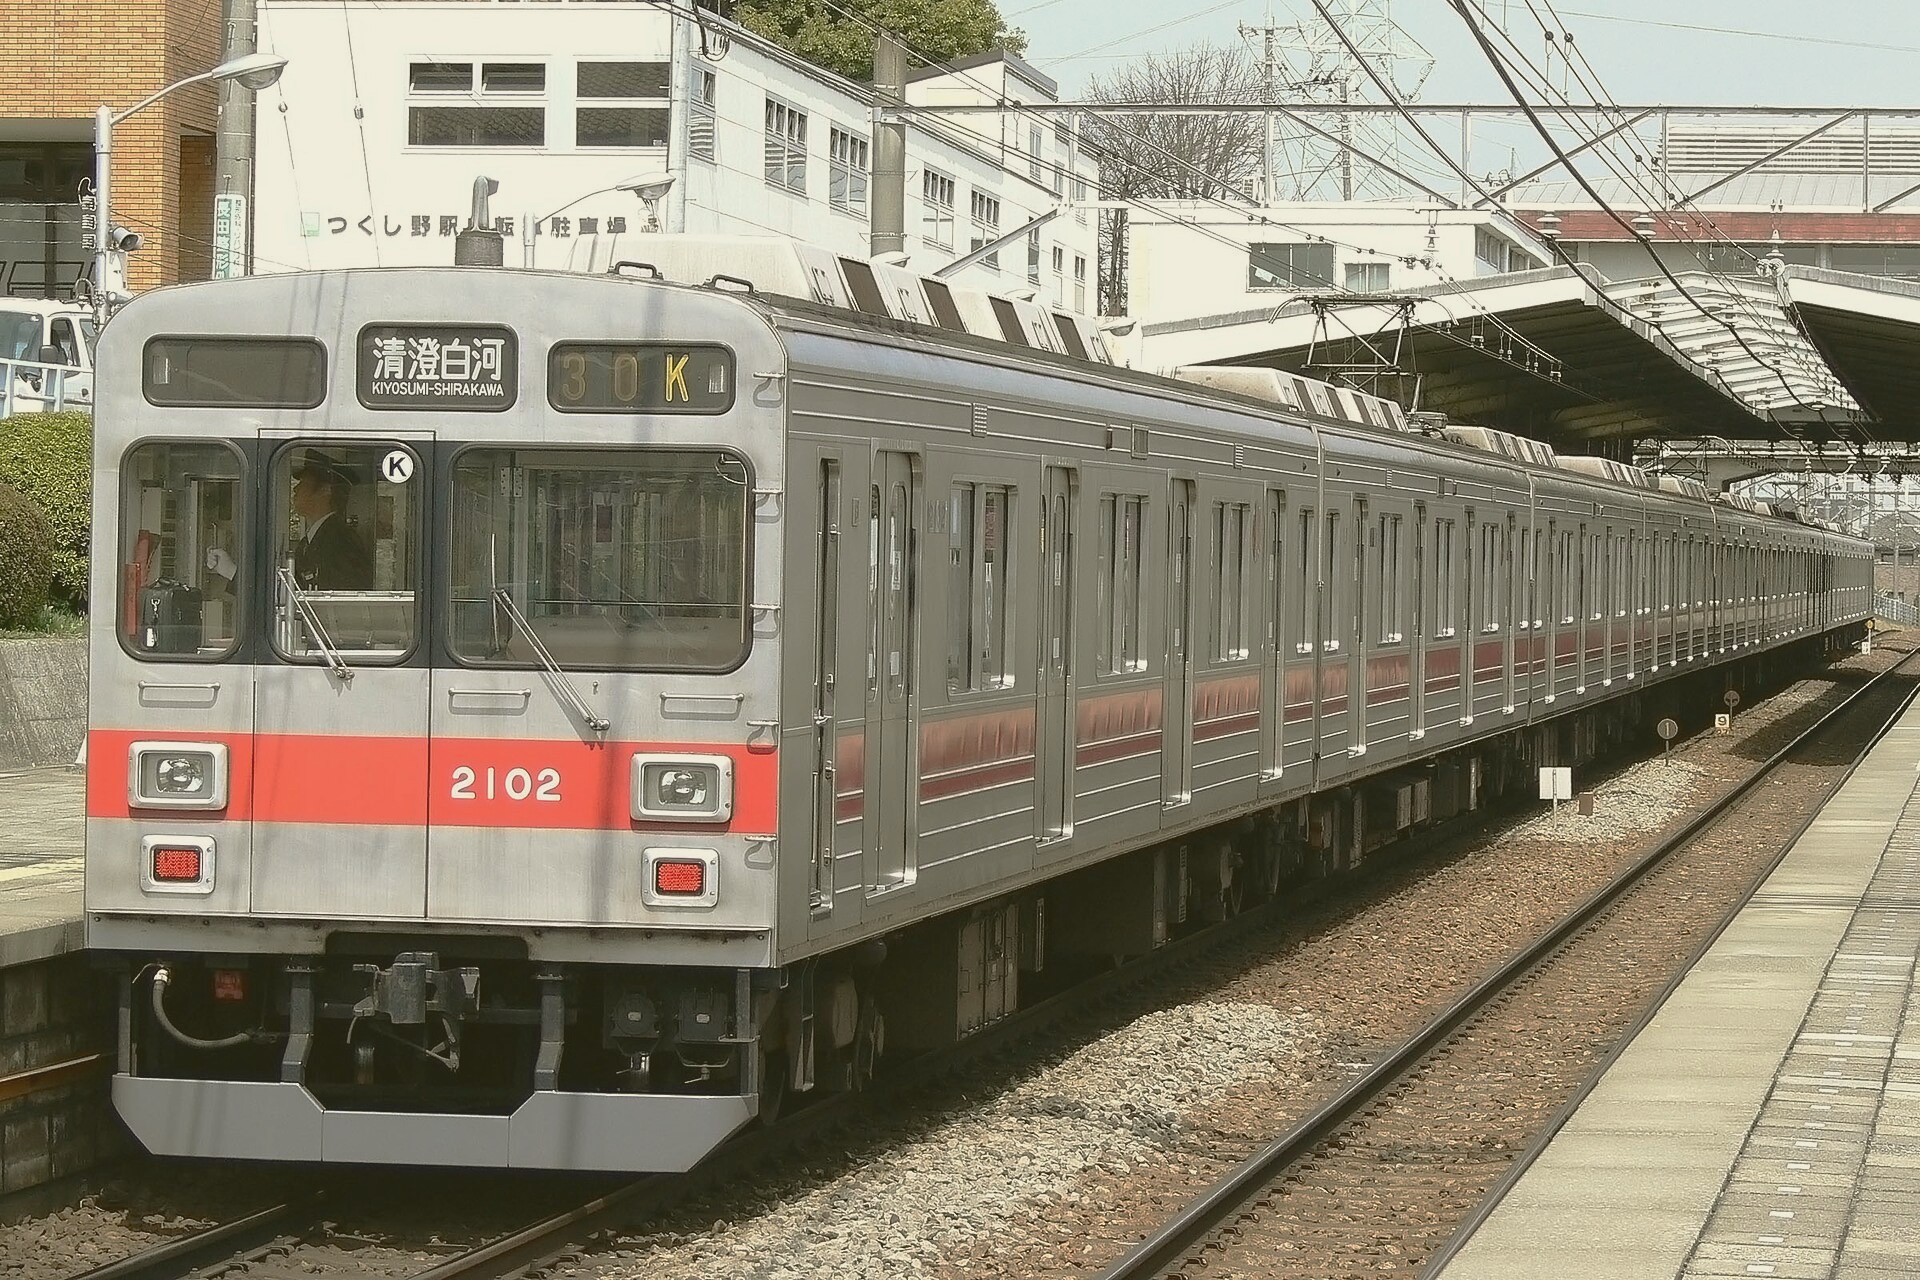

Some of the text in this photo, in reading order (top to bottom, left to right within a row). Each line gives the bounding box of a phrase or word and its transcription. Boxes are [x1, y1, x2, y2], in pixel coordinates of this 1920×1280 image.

[327, 214, 626, 238] つくし野駅転駐車場
[373, 337, 505, 381] 清澄白河
[371, 381, 505, 397] KIYOSUMI-SHIRAKAWA
[388, 456, 407, 477] K
[451, 766, 561, 801] 2102
